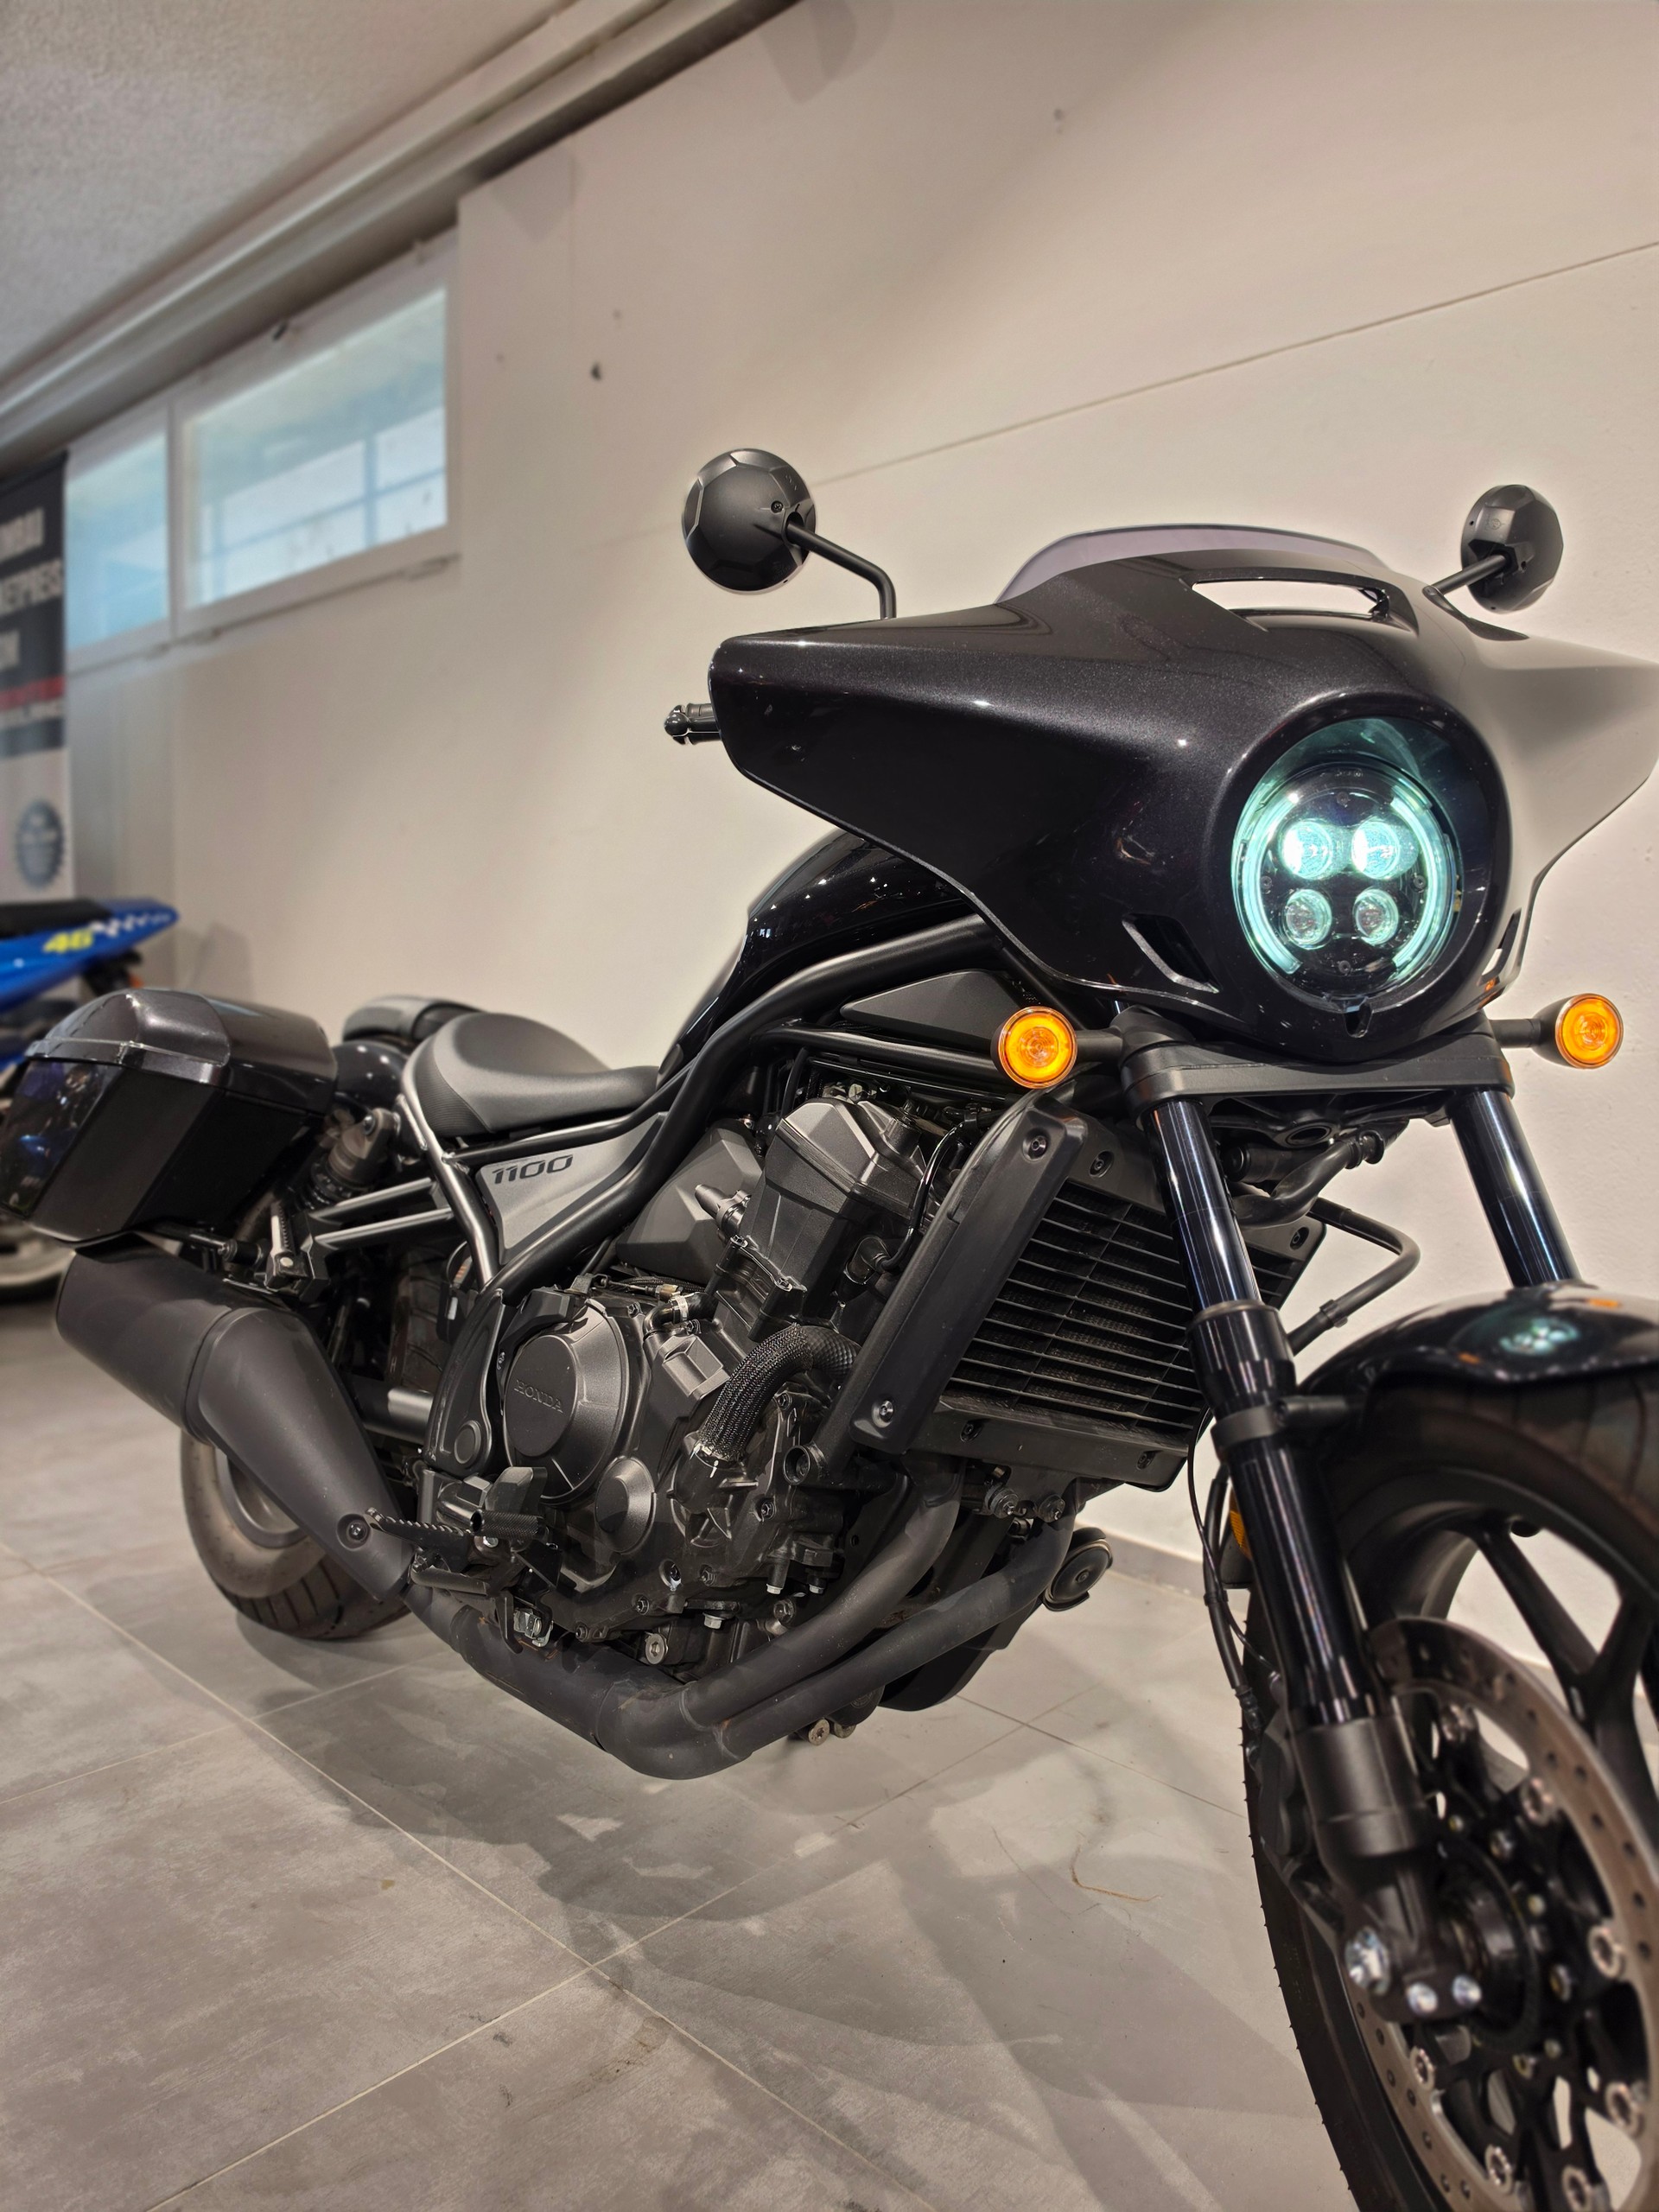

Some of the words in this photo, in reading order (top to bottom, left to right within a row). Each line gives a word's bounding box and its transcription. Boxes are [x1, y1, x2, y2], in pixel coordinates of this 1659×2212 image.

[43, 928, 92, 953] 46
[493, 1154, 573, 1184] 1100
[513, 1380, 563, 1414] HONDA
